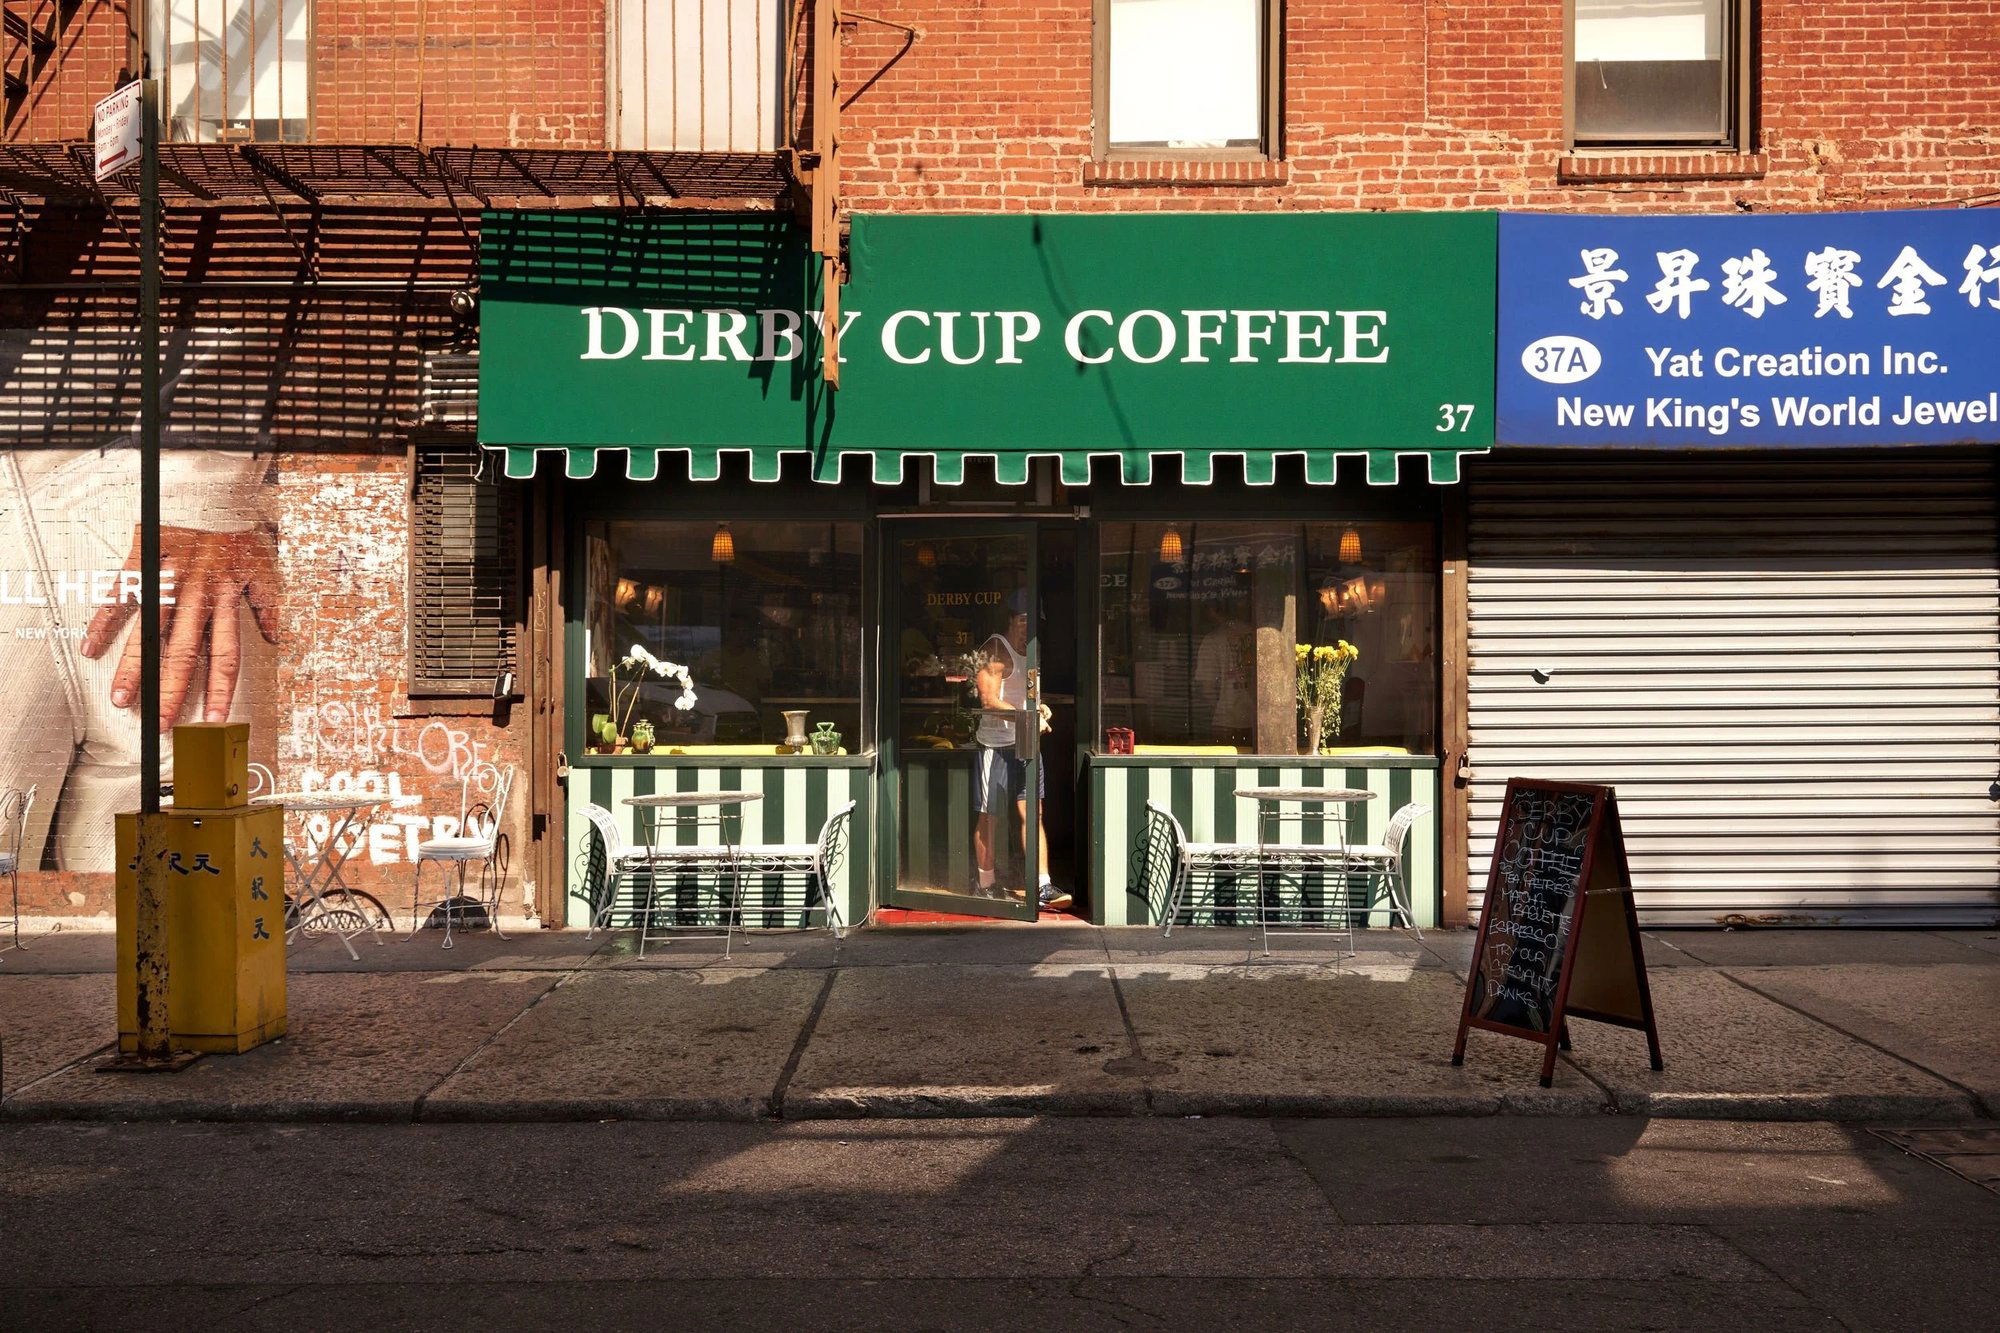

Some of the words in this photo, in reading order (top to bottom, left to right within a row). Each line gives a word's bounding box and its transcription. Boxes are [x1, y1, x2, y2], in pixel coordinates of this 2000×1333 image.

[97, 108, 105, 123] NO
[106, 94, 129, 115] PARKING
[97, 124, 113, 138] Monday
[116, 115, 129, 129] Friday
[580, 306, 861, 363] DERBY
[881, 308, 1041, 364] CUP
[1064, 309, 1390, 364] COFFEE
[1534, 346, 1588, 374] 37A
[1645, 347, 1704, 377] Yat
[1714, 346, 1870, 377] Creation
[1883, 345, 1948, 375] Inc.
[1436, 404, 1475, 432] 37
[1557, 396, 1635, 427] New
[1646, 397, 1760, 435] King's
[1772, 396, 1880, 427] World
[1892, 392, 1998, 426] Jewel
[57, 569, 176, 605] HERE
[927, 592, 972, 606] DERBY
[975, 592, 1002, 605] CUP
[15, 626, 47, 640] NEW
[52, 627, 88, 640] YORK
[955, 631, 968, 645] 37
[1517, 800, 1593, 833] DERBY
[1523, 822, 1572, 846] CUP
[1503, 840, 1581, 878] COFFEE
[250, 836, 270, 940] 大紀元
[1501, 871, 1520, 884] TEA
[1489, 917, 1559, 949] ESPRESSO
[1490, 943, 1518, 962] TRY
[1520, 947, 1546, 972] OUR
